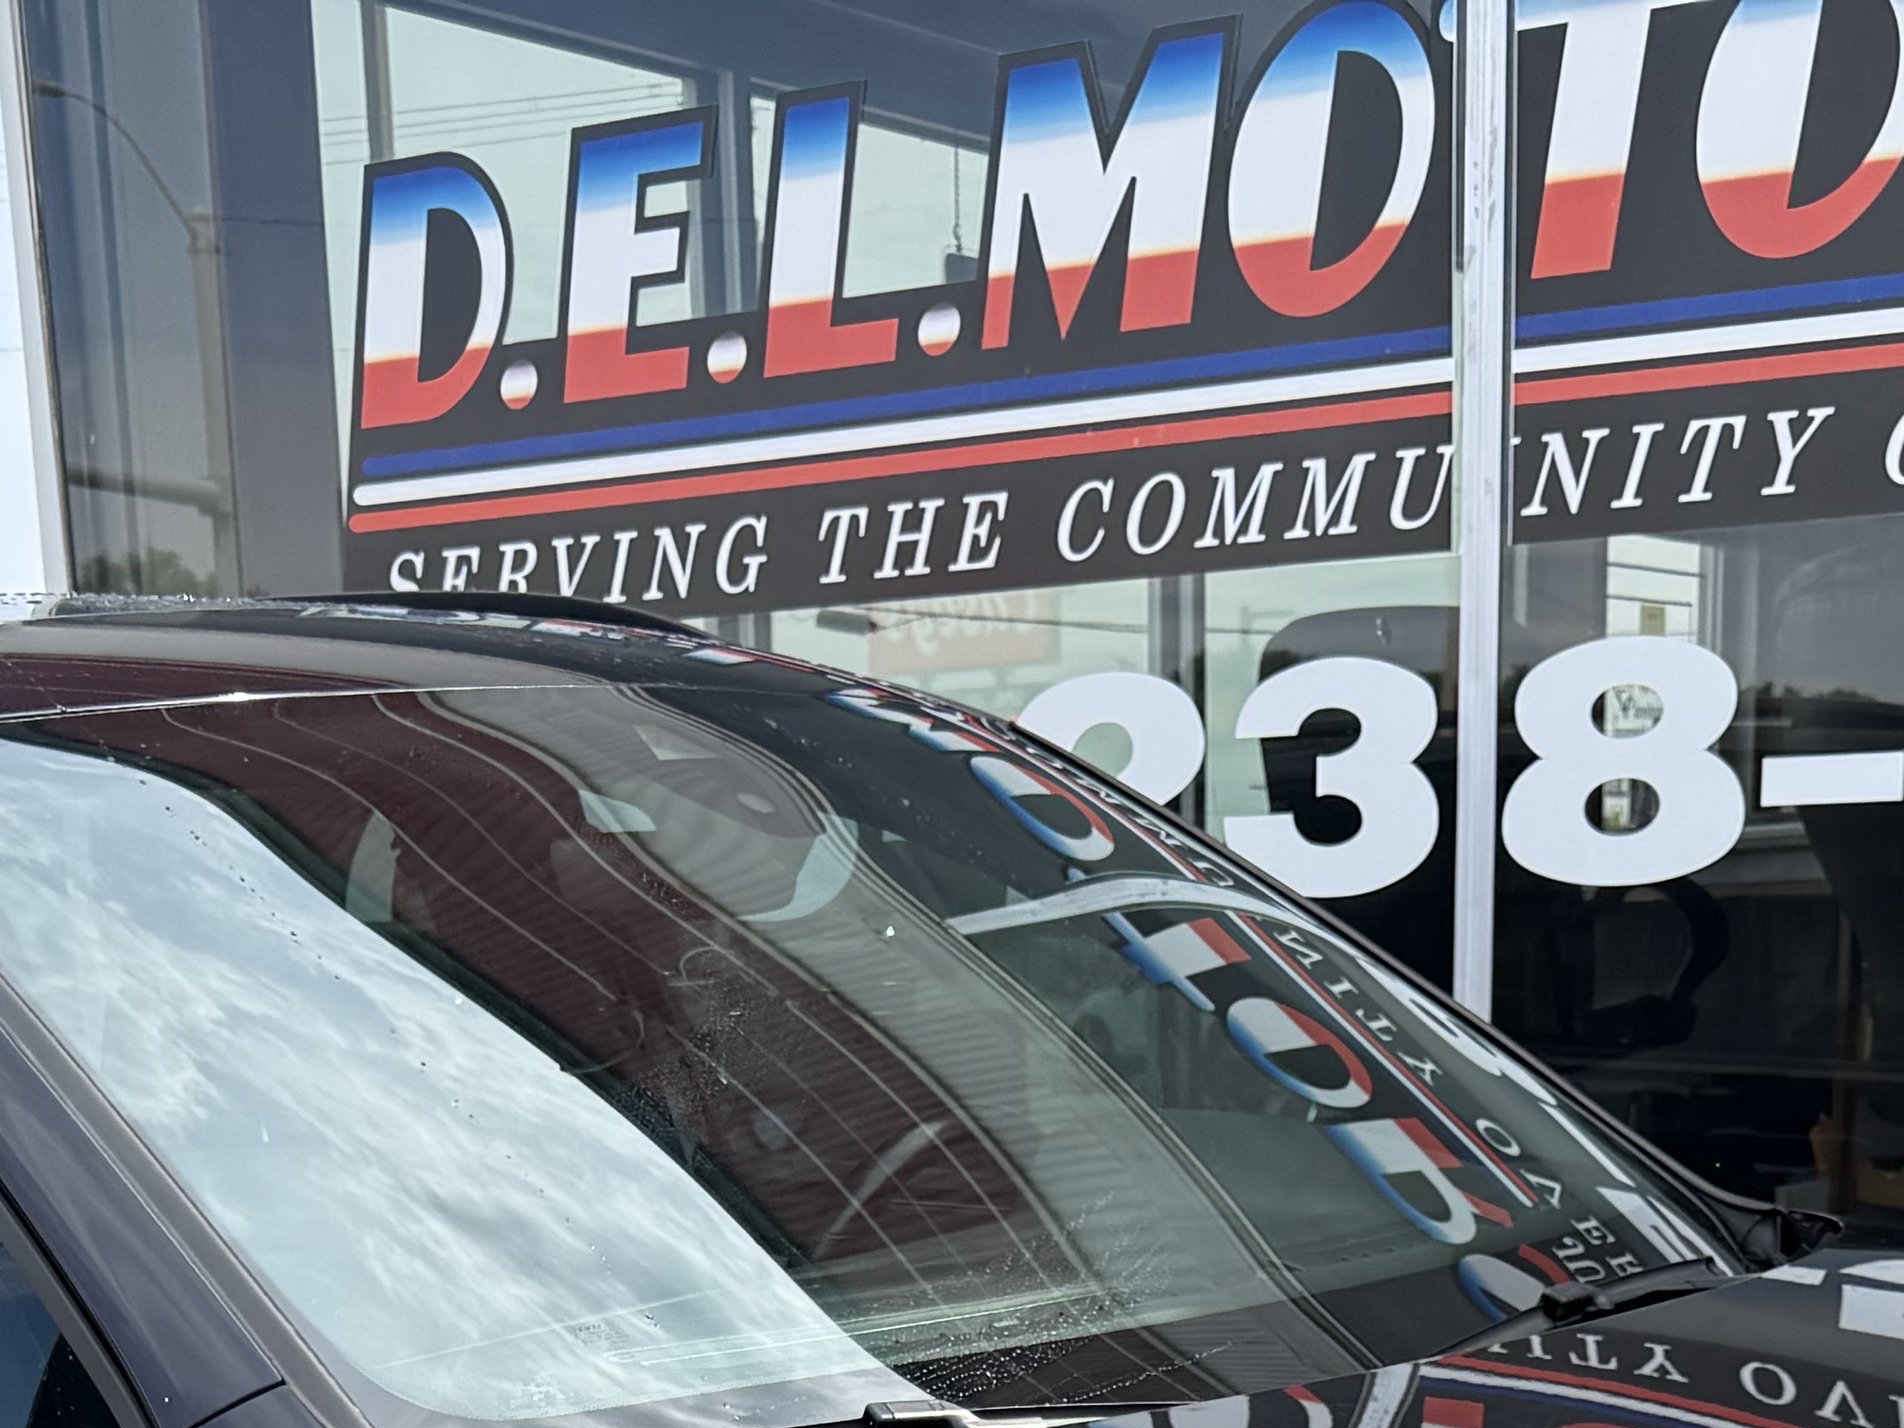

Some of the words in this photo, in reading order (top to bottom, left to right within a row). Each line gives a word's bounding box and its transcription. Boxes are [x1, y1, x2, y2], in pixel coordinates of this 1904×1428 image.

[389, 514, 769, 603] SERVING
[818, 494, 1010, 585] THE
[1059, 407, 1834, 564] COMMUNITY
